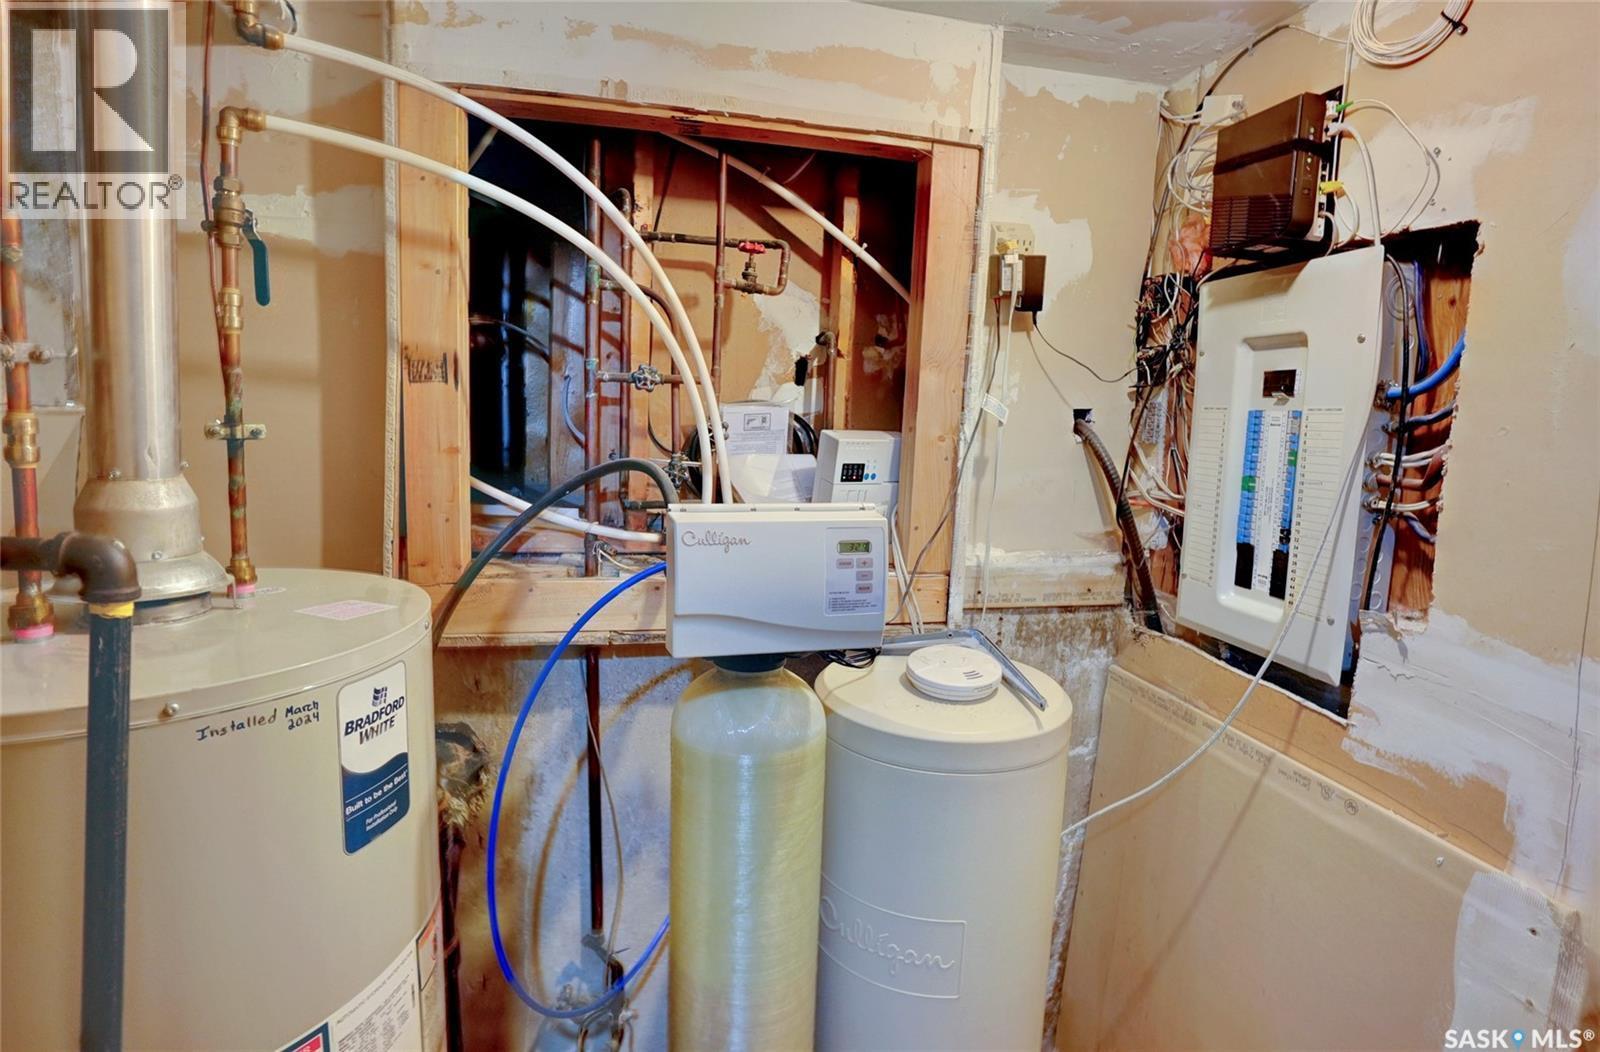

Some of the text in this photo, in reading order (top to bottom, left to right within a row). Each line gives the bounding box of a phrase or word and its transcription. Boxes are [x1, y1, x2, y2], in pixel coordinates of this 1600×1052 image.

[681, 530, 752, 553] Culligan
[195, 700, 320, 741] Installed March
[287, 711, 320, 731] 2024
[343, 695, 405, 737] BRADFORD
[358, 716, 397, 745] WHITE
[345, 800, 363, 816] Built
[364, 796, 373, 805] to
[372, 789, 383, 799] be
[819, 895, 956, 976] Culligan
